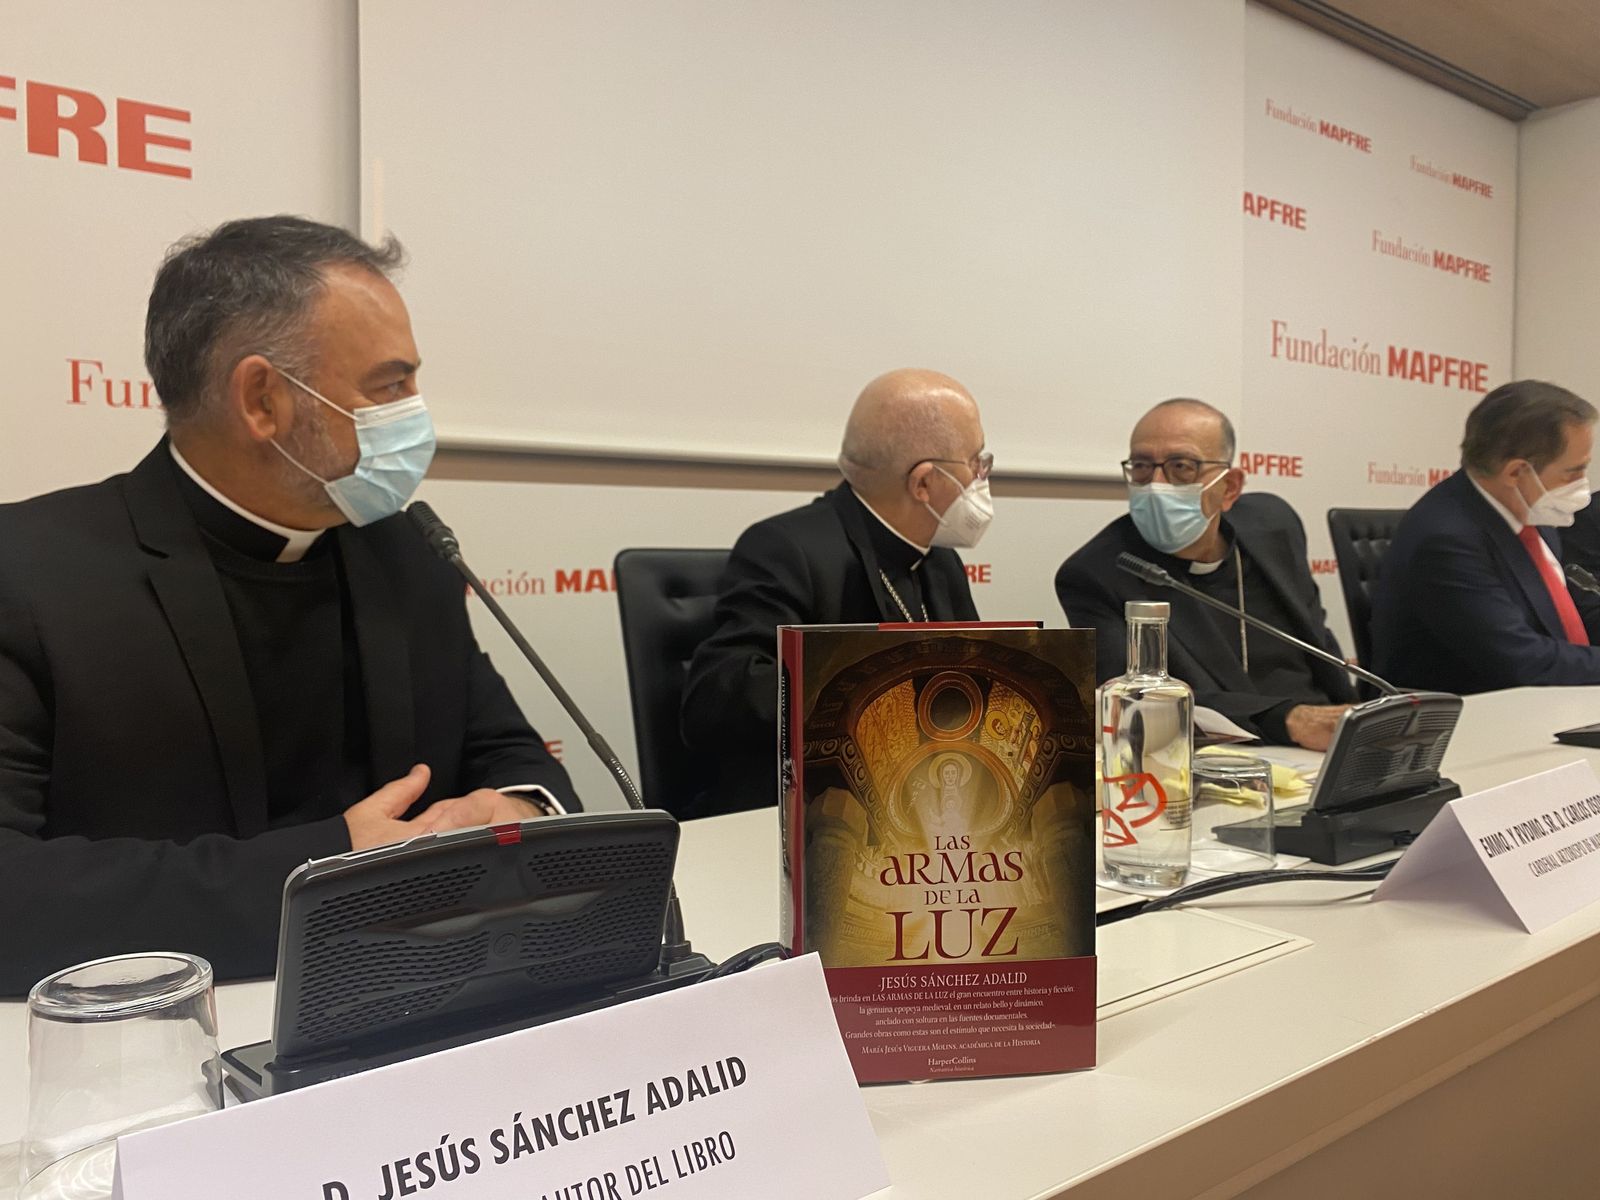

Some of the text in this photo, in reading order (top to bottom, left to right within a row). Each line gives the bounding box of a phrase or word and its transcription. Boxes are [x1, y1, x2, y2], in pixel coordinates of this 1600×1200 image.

[1265, 97, 1372, 154] Fundación MAPFRE
[1452, 172, 1494, 199] MAPFRE
[1372, 229, 1492, 284] Fundación MAPFRE
[1271, 319, 1489, 394] Fundación MAPFRE
[1368, 462, 1426, 488] Fundación
[1505, 827, 1521, 848] Y
[1553, 810, 1570, 829] D.
[1562, 800, 1593, 825] CARLOS
[885, 906, 1020, 962] LUZ
[920, 972, 980, 988] SÁNCHEZ
[982, 972, 1028, 985] ADALID
[839, 994, 861, 1003] brinda
[872, 993, 886, 1002] LAS
[887, 991, 913, 1001] ARMAS
[914, 991, 924, 1000] DE
[924, 991, 935, 1000] LA
[935, 990, 949, 999] LUZ
[949, 990, 956, 999] el
[956, 991, 972, 1000] gran
[972, 989, 1006, 998] encuentro
[1006, 988, 1023, 996] entre
[1024, 986, 1048, 995] historia
[1047, 987, 1053, 996] y
[1053, 985, 1074, 994] ficción
[859, 1006, 866, 1014] la
[866, 1006, 893, 1015] genuina
[894, 1005, 921, 1014] epopeya
[963, 1002, 972, 1010] un
[973, 1001, 992, 1010] relato
[992, 1000, 1008, 1009] bello
[1008, 1001, 1013, 1010] y
[845, 1030, 873, 1040] Grandes
[873, 1029, 892, 1038] obras
[942, 1026, 949, 1034] el
[949, 1025, 977, 1034] estímulo
[978, 1027, 990, 1035] que
[991, 1024, 1017, 1032] necesita
[1018, 1023, 1024, 1031] la
[875, 1017, 901, 1026] anclado
[915, 1016, 939, 1025] soltura
[948, 1015, 960, 1023] las
[960, 1013, 983, 1022] fuentes
[928, 1056, 976, 1067] HarperCollins
[377, 1134, 481, 1200] JESÚS
[488, 1089, 636, 1165] SÁNCHEZ
[645, 1056, 748, 1116] ADALID
[624, 1154, 670, 1197] DEL
[671, 1130, 737, 1179] LIBRO
